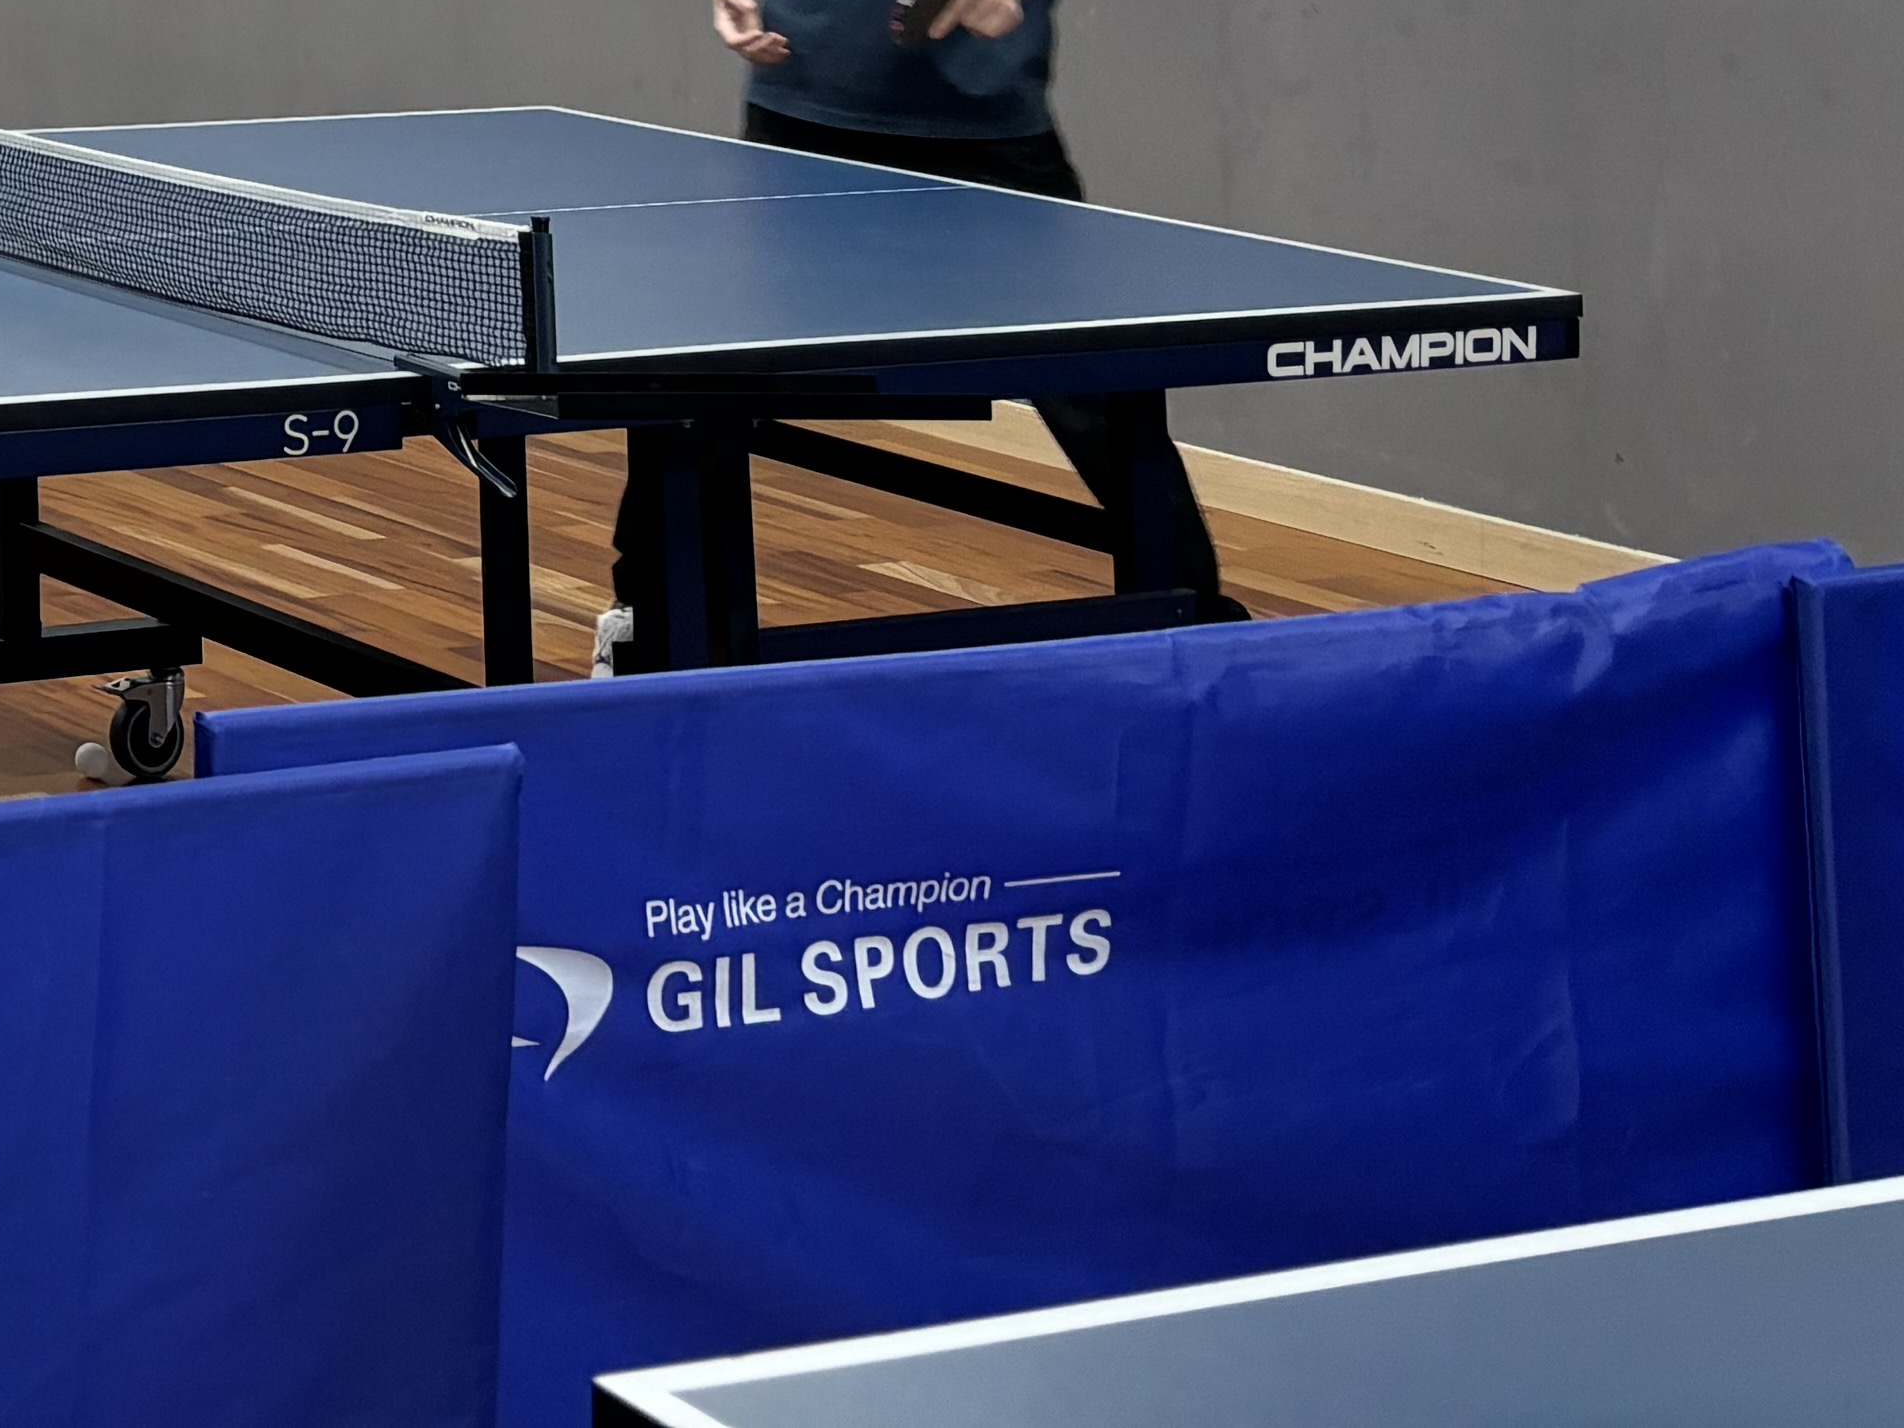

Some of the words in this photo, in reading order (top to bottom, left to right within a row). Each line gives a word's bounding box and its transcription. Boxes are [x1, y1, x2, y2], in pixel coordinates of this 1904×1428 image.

[1267, 325, 1537, 378] CHAMPION
[283, 410, 359, 455] S-9
[646, 898, 715, 941] Play
[723, 889, 777, 928] like
[785, 891, 806, 919] a
[816, 871, 992, 914] Champion
[647, 952, 782, 1033] GIL
[801, 908, 1113, 1017] SPORTS
